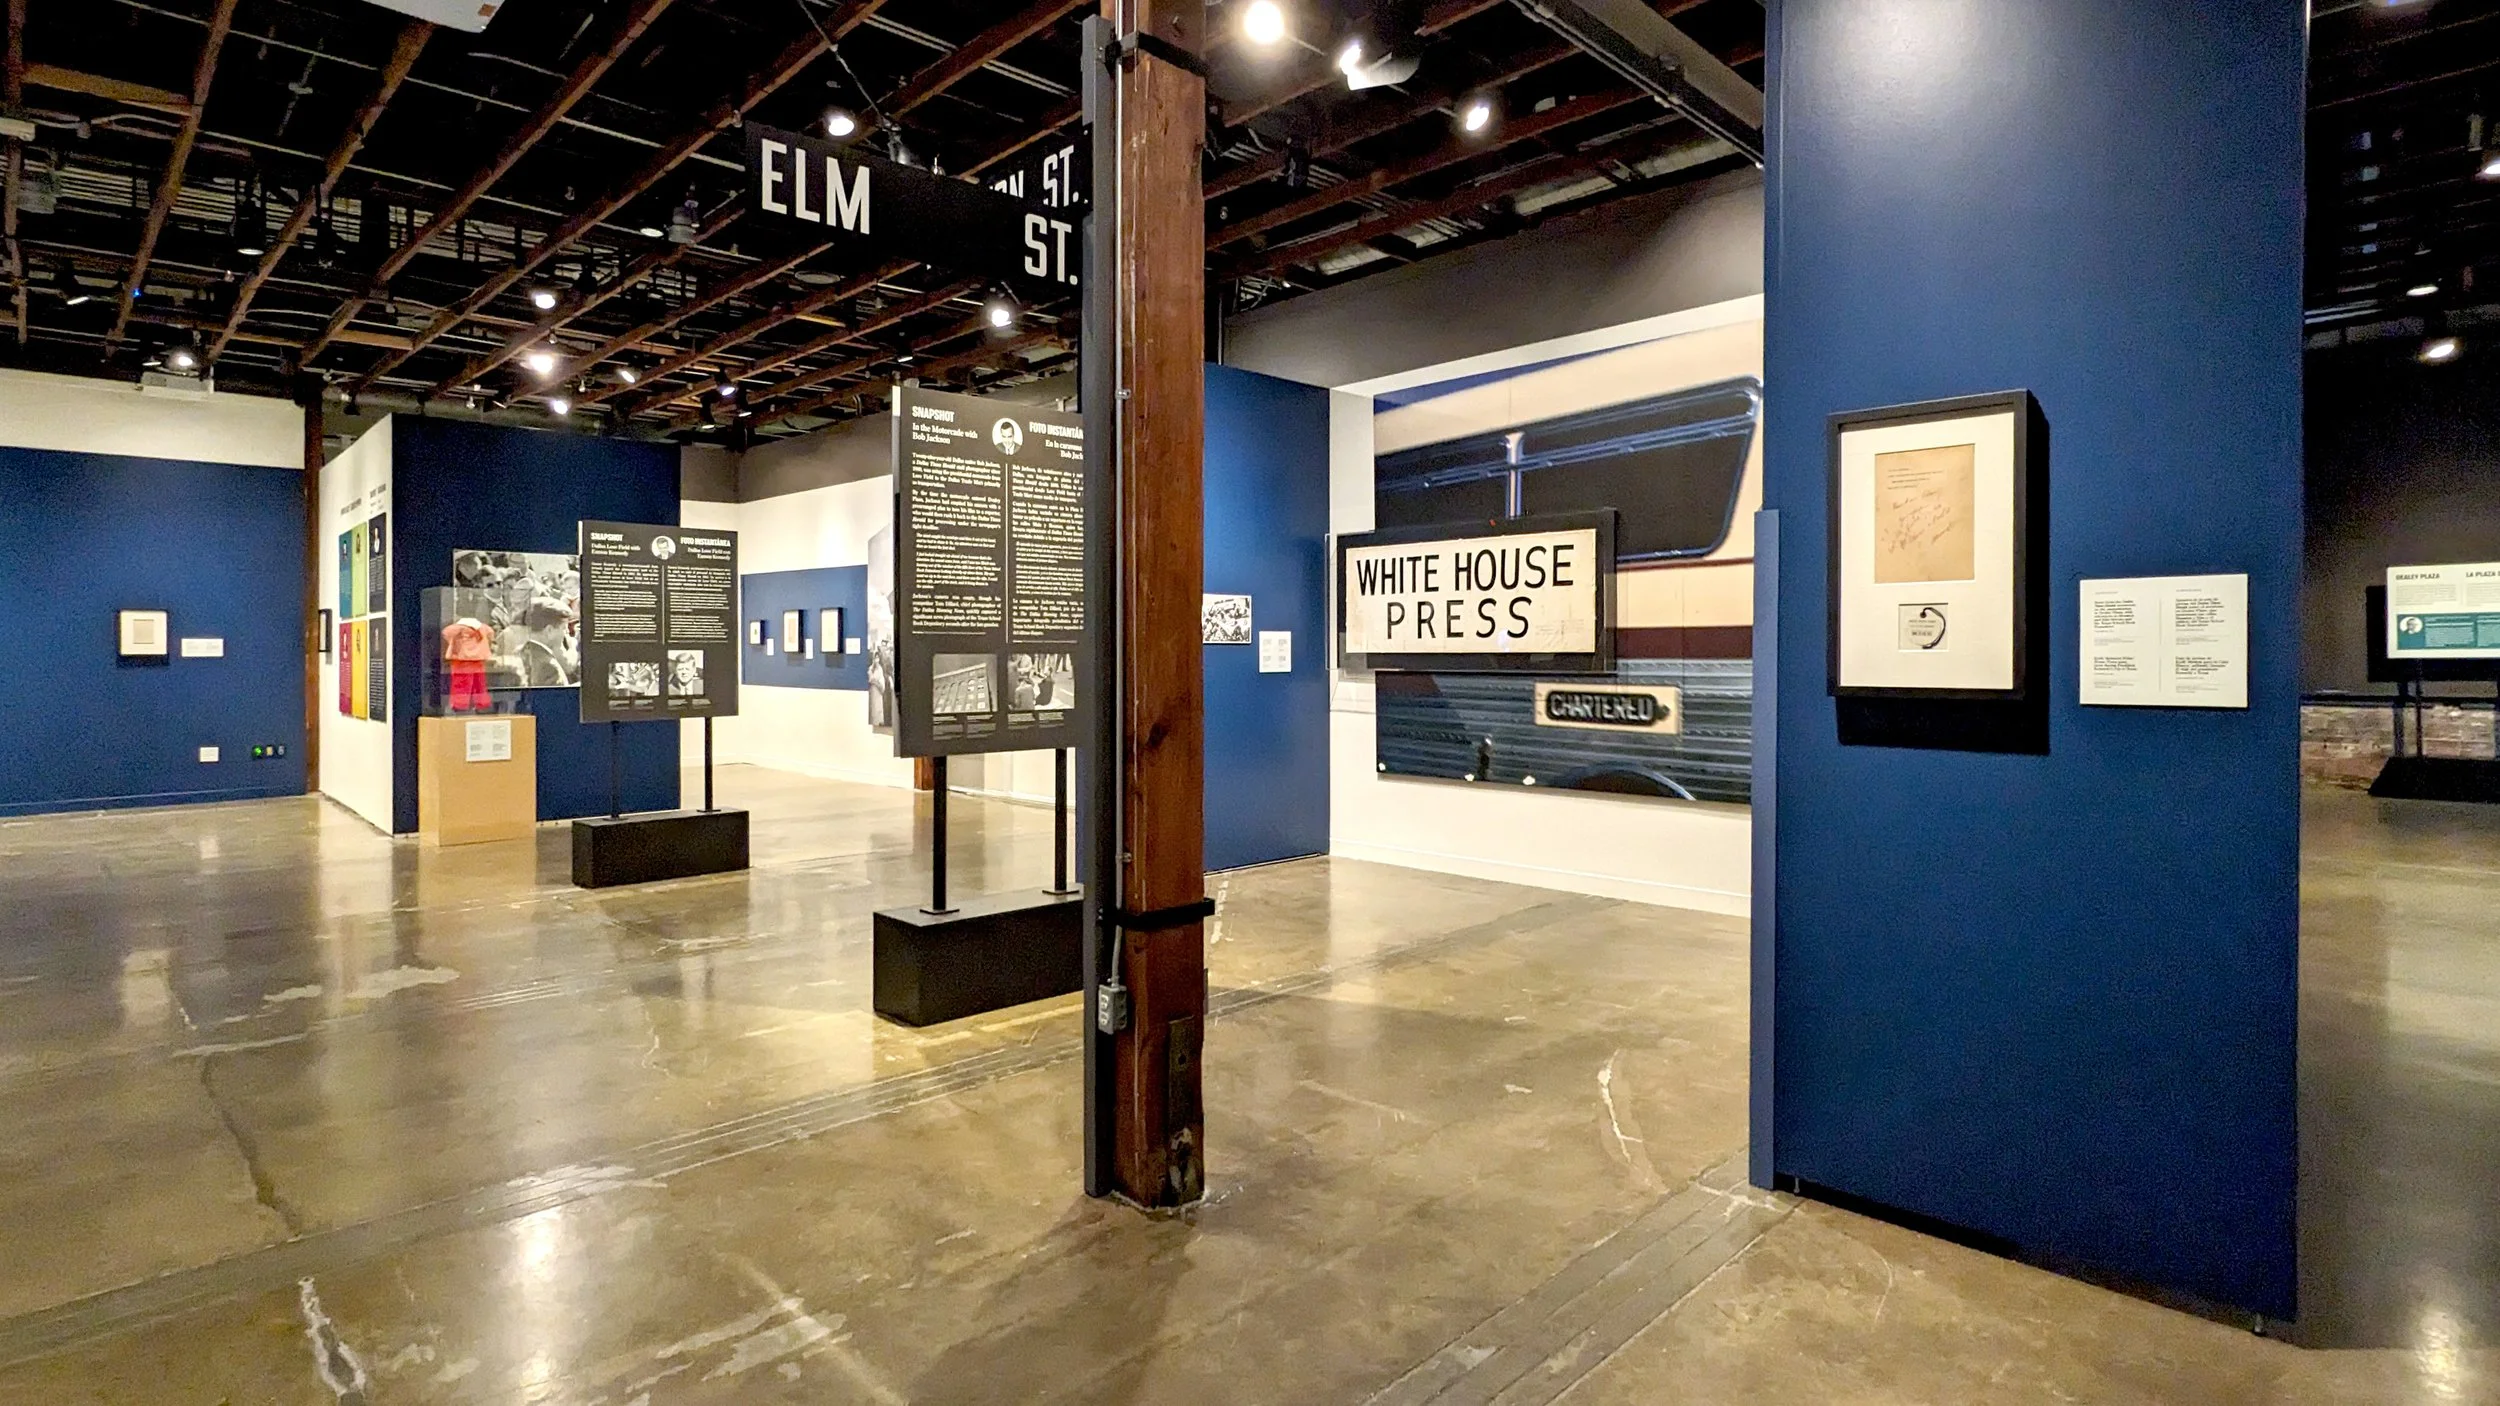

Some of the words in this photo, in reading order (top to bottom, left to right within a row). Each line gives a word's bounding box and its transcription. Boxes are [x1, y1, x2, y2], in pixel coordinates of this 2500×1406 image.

[1043, 145, 1079, 208] ST.
[761, 138, 870, 235] ELM
[1024, 213, 1078, 286] ST.
[912, 405, 955, 422] SNAPSHOT
[912, 422, 920, 431] In
[920, 423, 931, 433] the
[931, 425, 965, 437] Motorcade
[964, 429, 978, 439] with
[912, 431, 926, 441] Bob
[926, 434, 951, 445] Jackson
[1029, 421, 1047, 435] FOTO
[1047, 424, 1083, 439] INSTANTÁN
[1045, 439, 1054, 448] En
[1060, 450, 1072, 459] Bob
[1072, 451, 1083, 460] Jack
[590, 532, 624, 542] SNAPSHOT
[1357, 554, 1440, 597] WHITE
[1454, 544, 1575, 592] HOUSE
[1387, 596, 1533, 640] PRESS
[1549, 692, 1654, 721] CHARTERED
